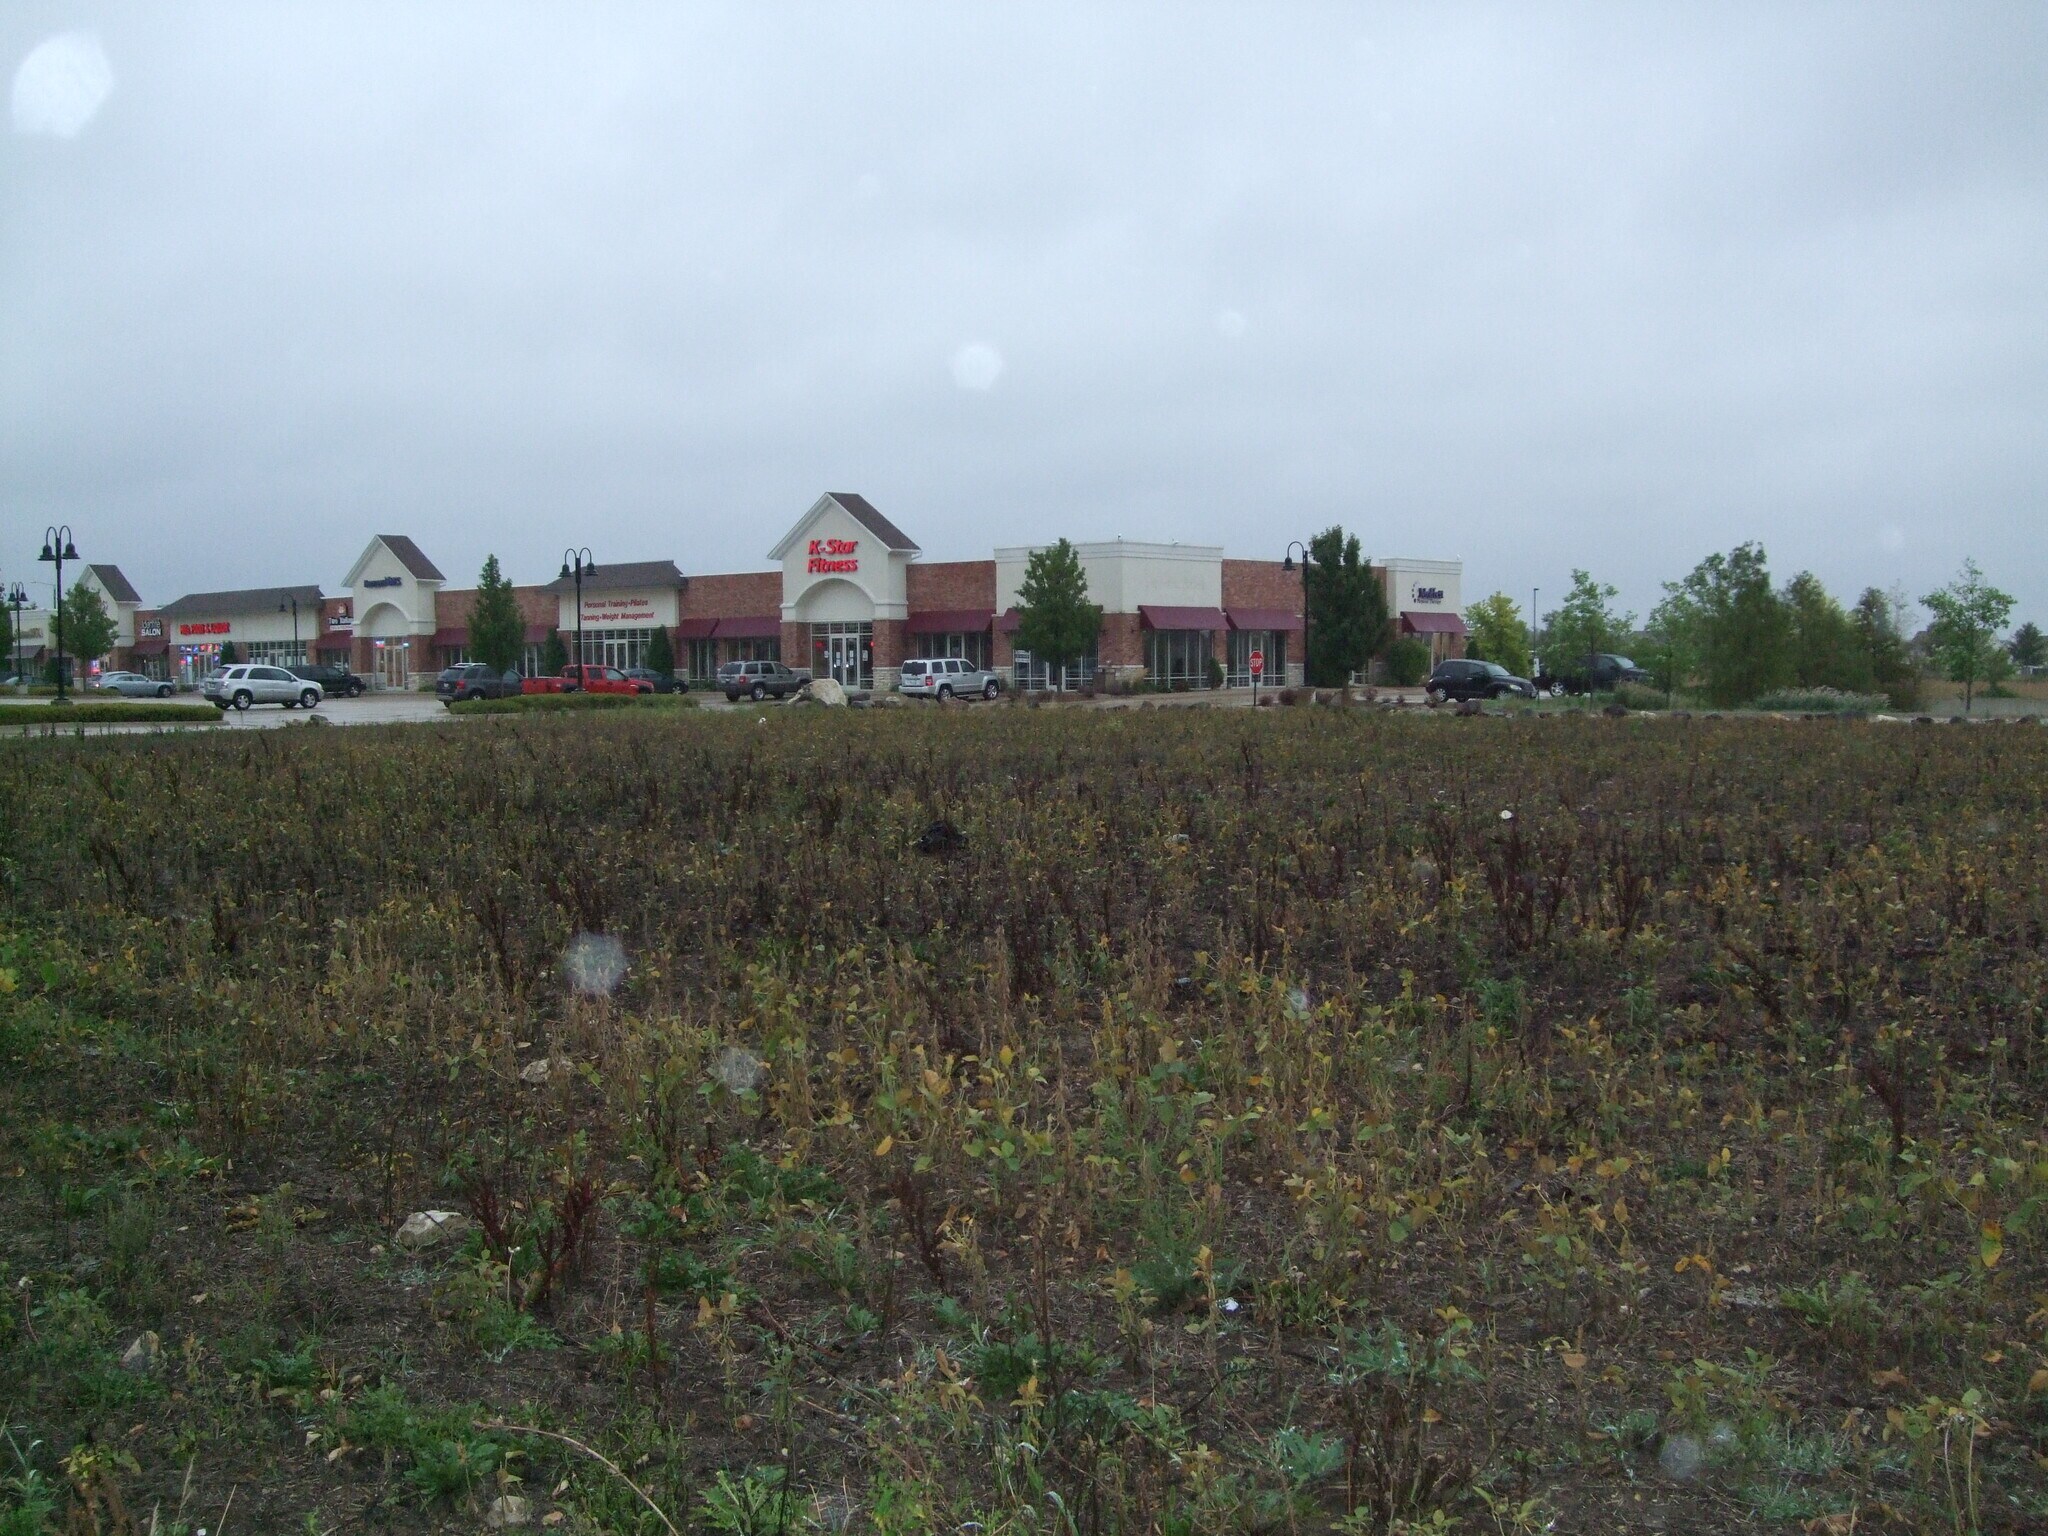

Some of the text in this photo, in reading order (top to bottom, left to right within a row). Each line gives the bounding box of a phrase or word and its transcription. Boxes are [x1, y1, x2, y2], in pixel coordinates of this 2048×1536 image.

[808, 538, 859, 555] K-Star
[807, 557, 858, 573] Fitness
[584, 600, 607, 609] Personal
[620, 611, 655, 621] Management
[141, 628, 162, 636] SALON
[1250, 658, 1262, 667] STOP
